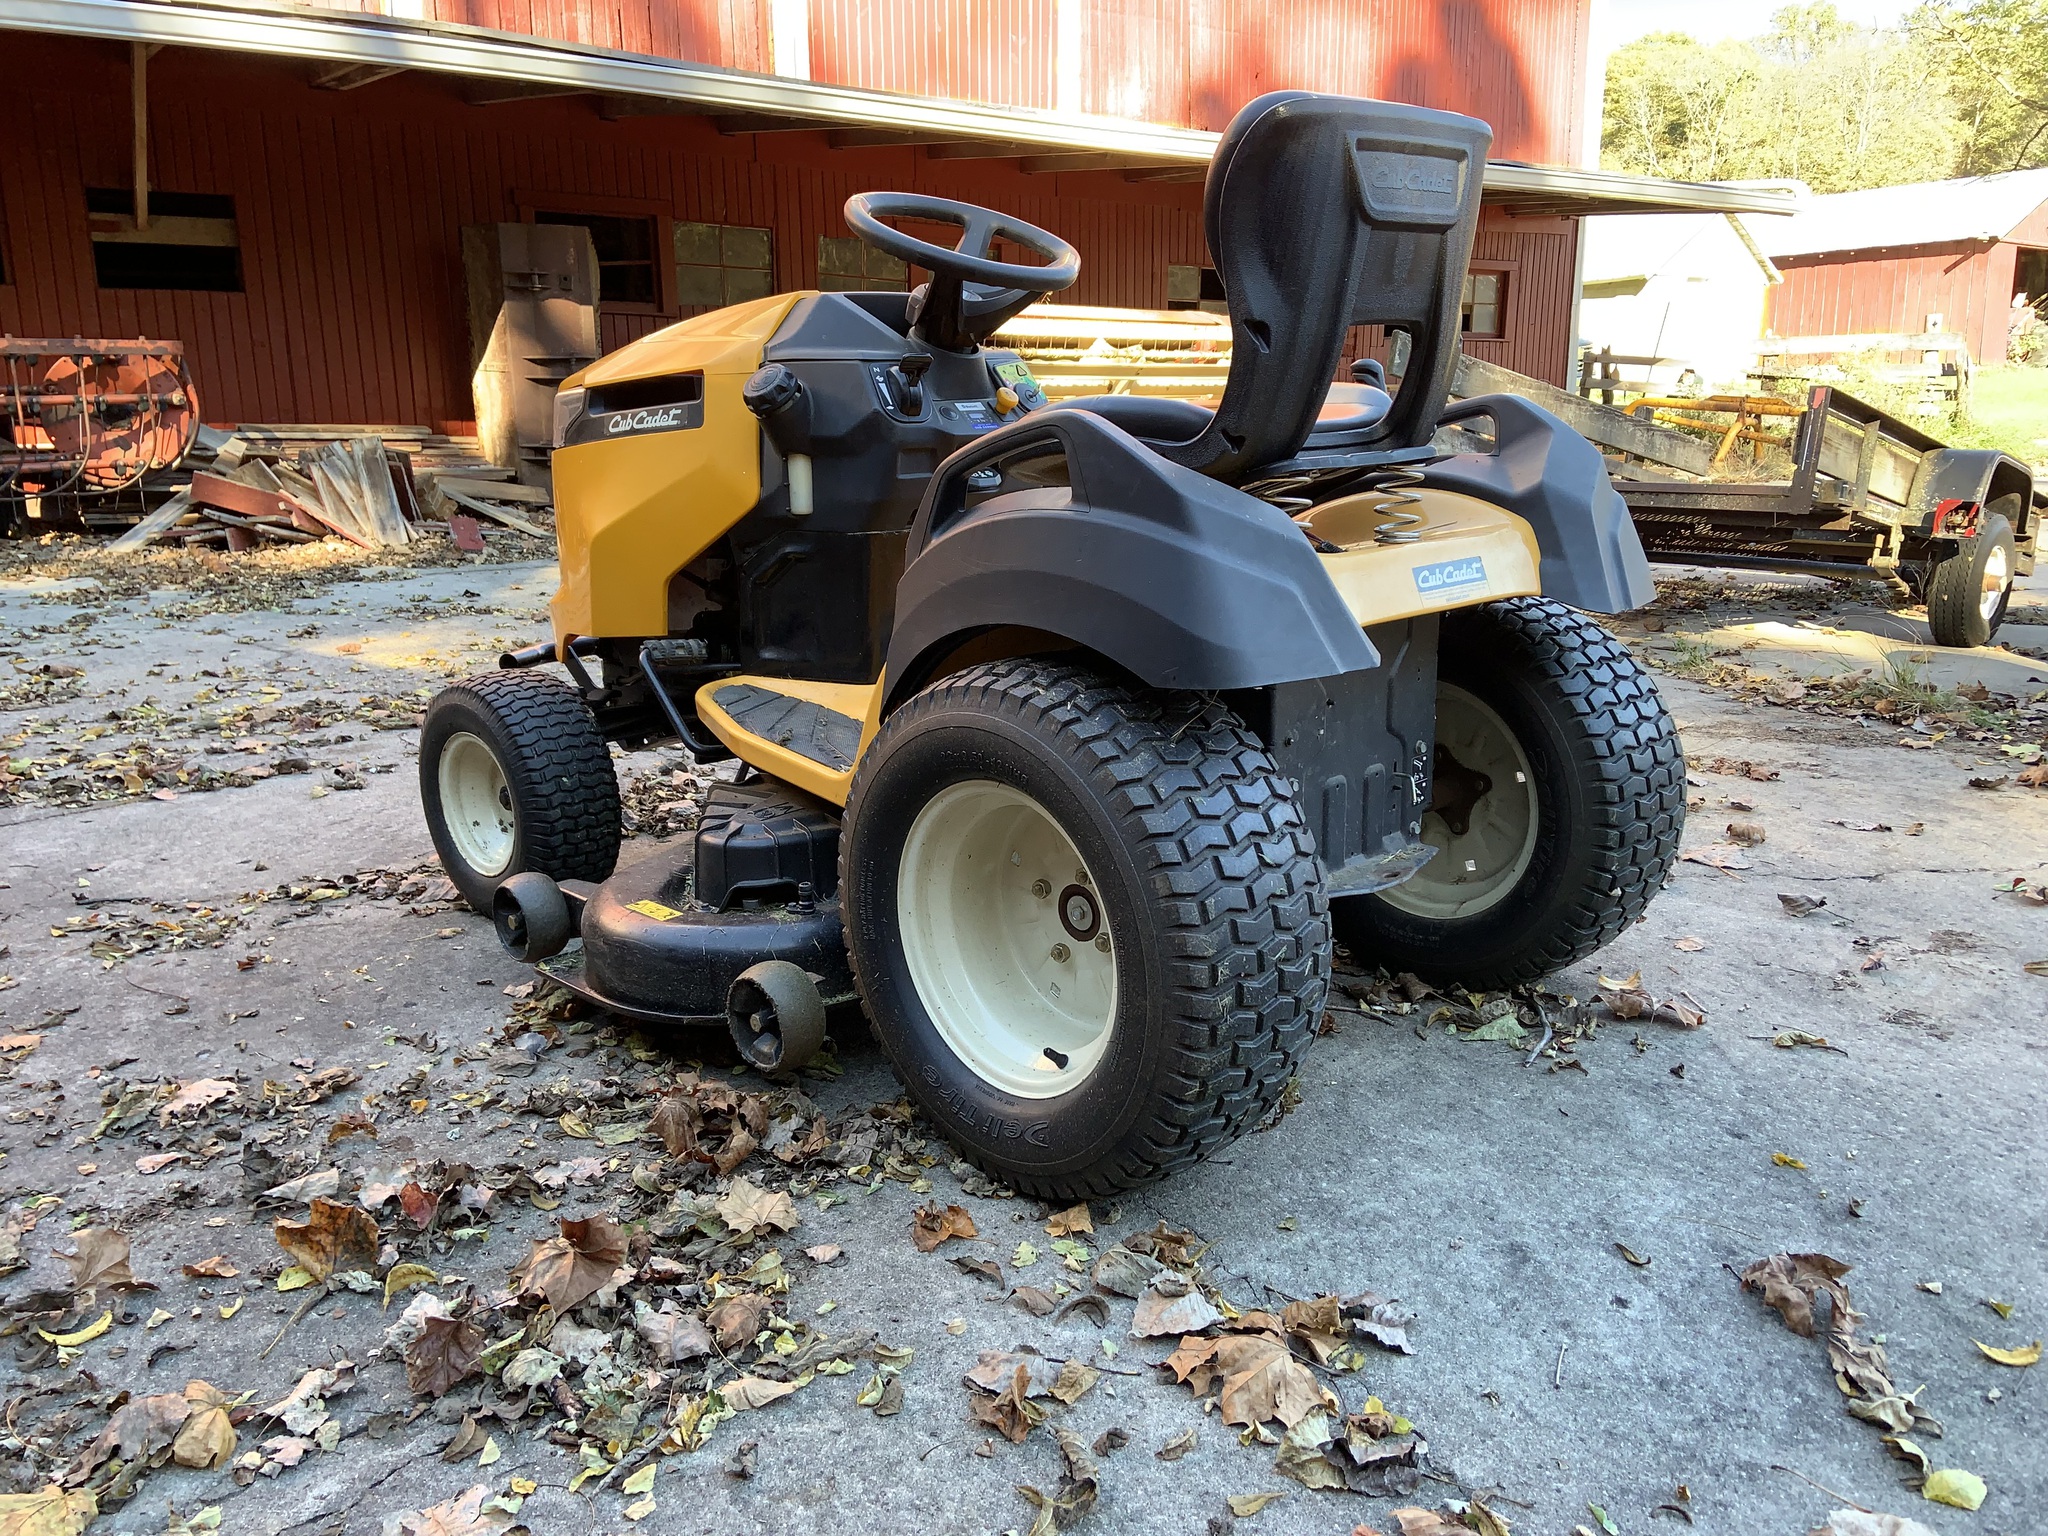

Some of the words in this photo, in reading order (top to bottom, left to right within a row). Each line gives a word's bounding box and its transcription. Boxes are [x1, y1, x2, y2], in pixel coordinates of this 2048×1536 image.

[608, 413, 632, 433] Cub
[632, 407, 682, 430] Cadet
[1418, 568, 1443, 588] Cub
[1443, 562, 1482, 583] Cadet
[922, 1064, 980, 1127] Tire
[983, 1112, 1049, 1148] Deli
